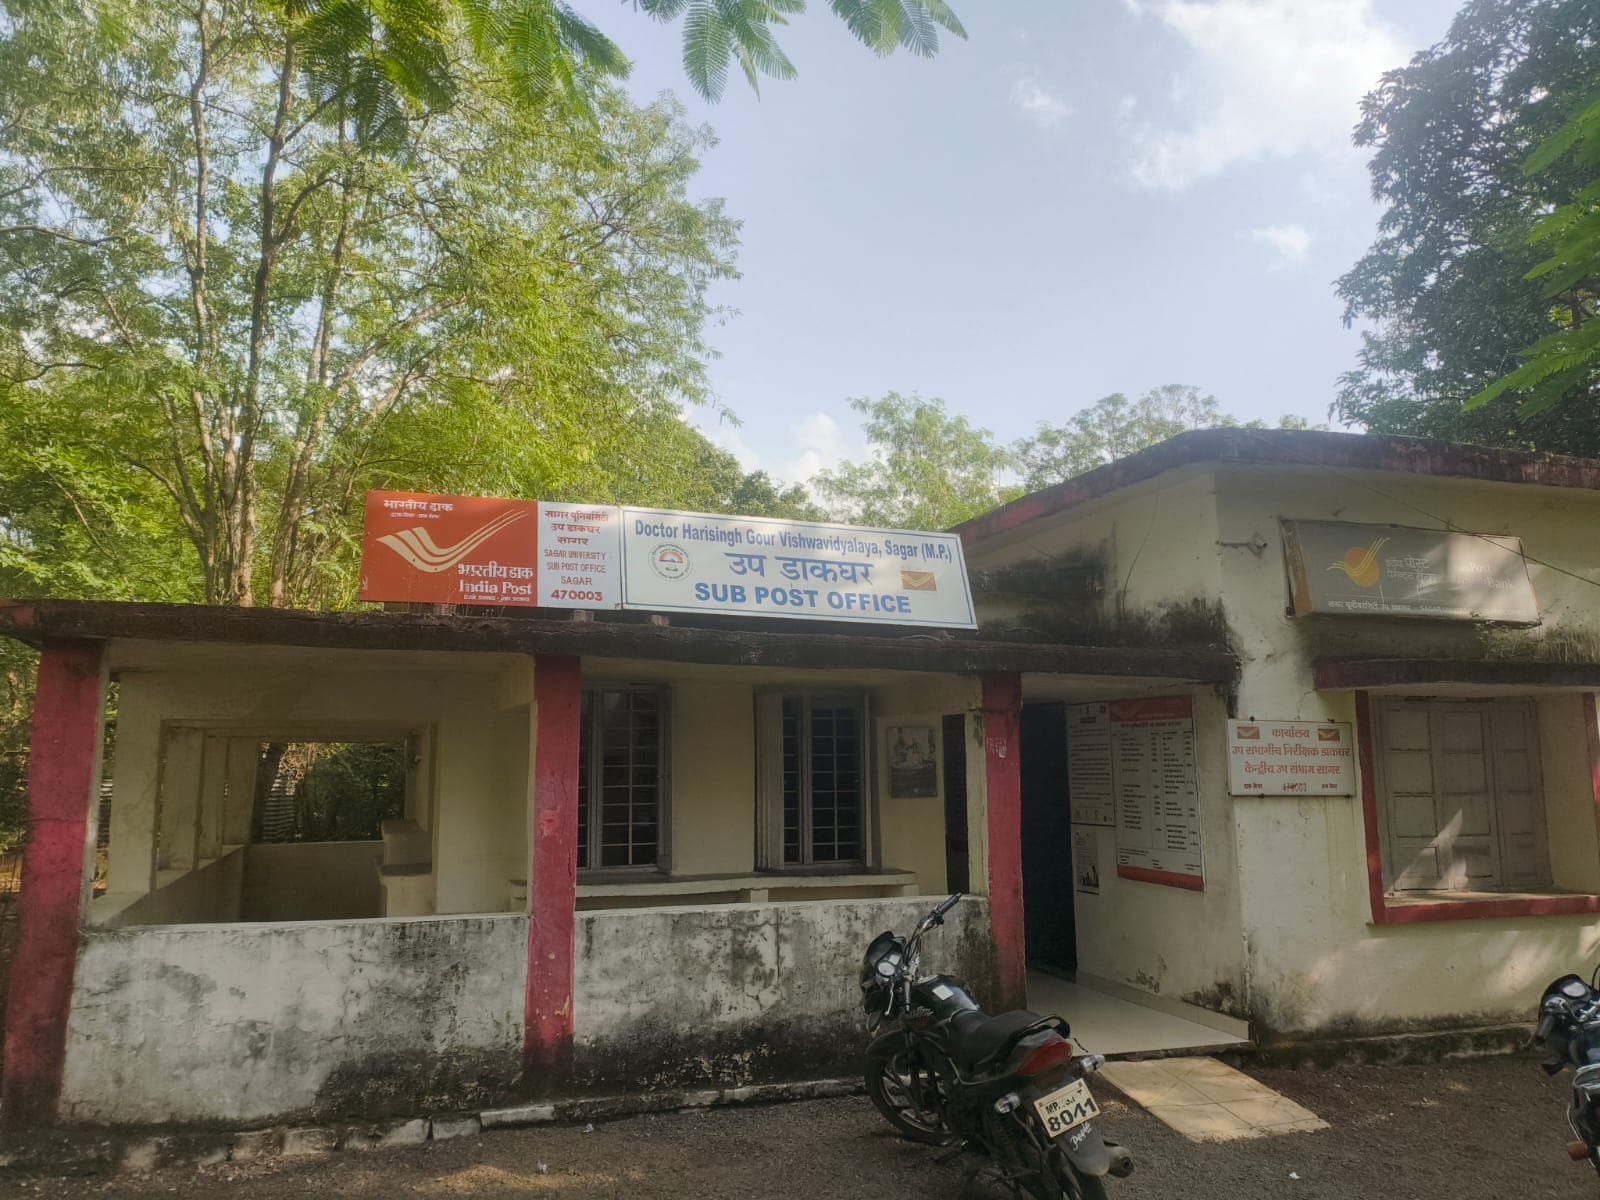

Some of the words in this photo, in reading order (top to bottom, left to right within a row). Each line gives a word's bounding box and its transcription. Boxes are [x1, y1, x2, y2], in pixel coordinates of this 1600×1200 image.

[384, 499, 427, 510] भारतीय
[429, 502, 454, 512] डाक
[545, 510, 569, 519] सागर
[551, 523, 565, 531] उप
[567, 524, 601, 534] डाकघर
[557, 536, 589, 545] सागर
[635, 520, 679, 538] Doctor
[682, 523, 742, 547] Harisingh
[746, 529, 775, 546] Gour
[779, 532, 882, 559] Vishwavidyalaya,
[885, 540, 918, 560] Sagar
[921, 543, 952, 564] (M.P.)
[568, 551, 606, 560] UNIVERSITY
[458, 560, 508, 578] भारतीय
[509, 566, 534, 579] डाक
[561, 562, 579, 571] POST
[580, 563, 607, 573] OFFICE
[725, 552, 767, 577] उप
[775, 556, 874, 585] डाकघर
[560, 576, 593, 586] SAGAR
[459, 580, 498, 594] India
[502, 581, 532, 595] Post
[551, 590, 604, 602] 470003
[695, 582, 746, 603] SUB
[755, 586, 818, 608] POST
[827, 591, 912, 613] OFFICE
[1272, 726, 1310, 738] कार्यालय
[1232, 746, 1244, 754] उप
[1276, 766, 1288, 774] उप
[1316, 766, 1342, 774] सागर
[1047, 1097, 1097, 1132] 8041
